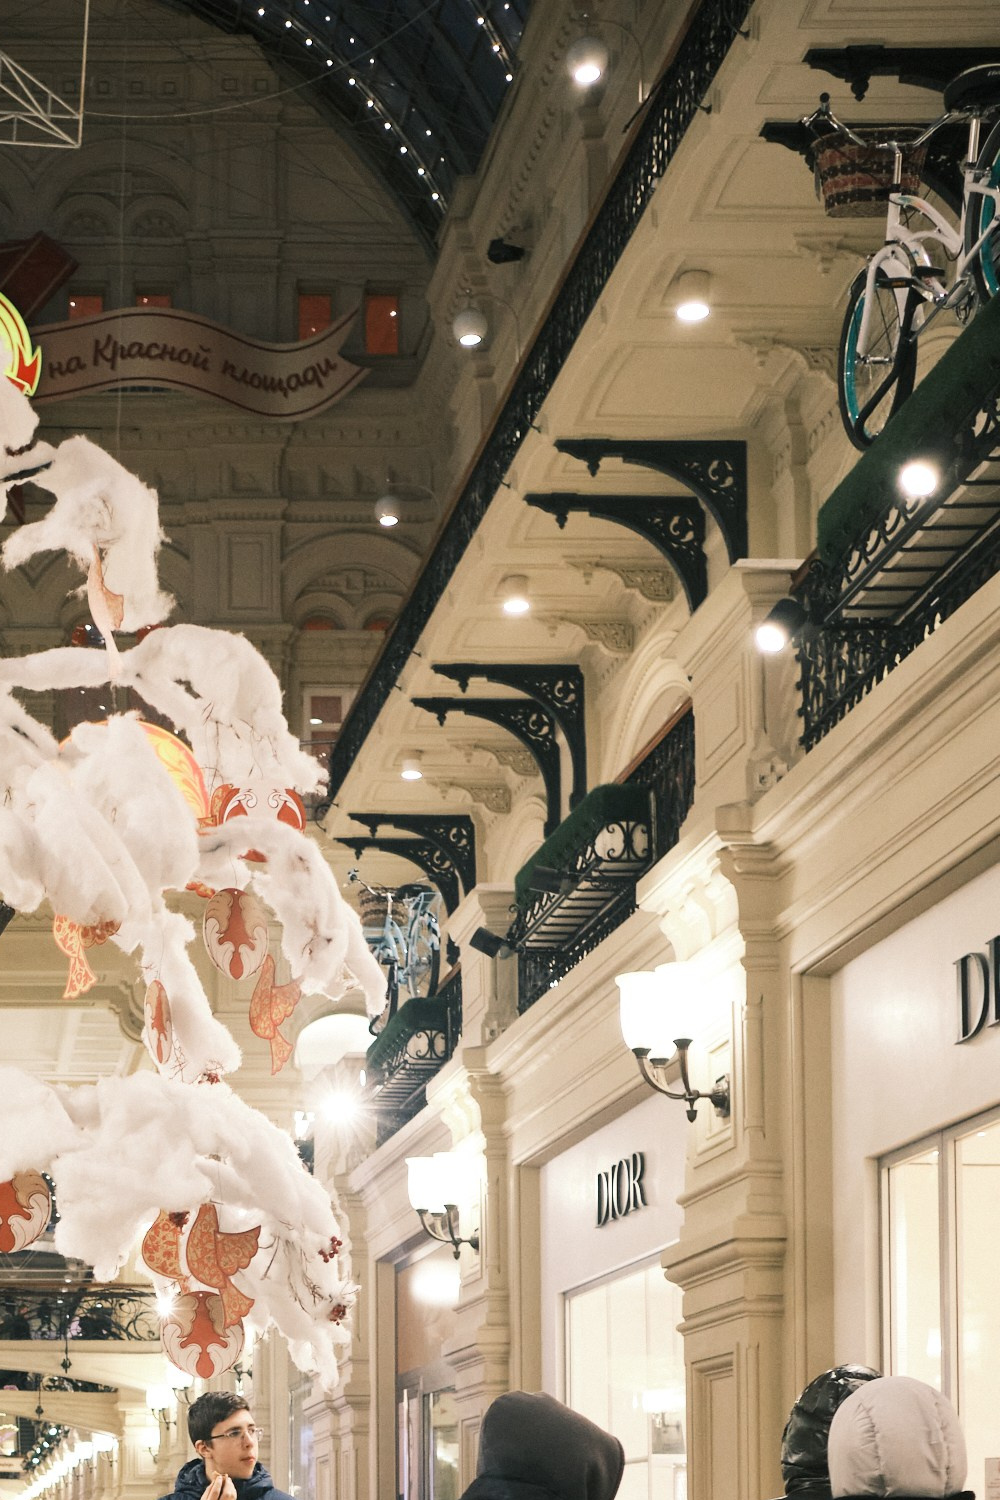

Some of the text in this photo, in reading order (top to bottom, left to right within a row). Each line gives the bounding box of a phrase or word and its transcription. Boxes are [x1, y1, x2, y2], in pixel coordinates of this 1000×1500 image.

[49, 354, 87, 379] на
[92, 334, 212, 373] Красной
[220, 357, 339, 398] площади
[594, 1151, 647, 1229] DIOR
